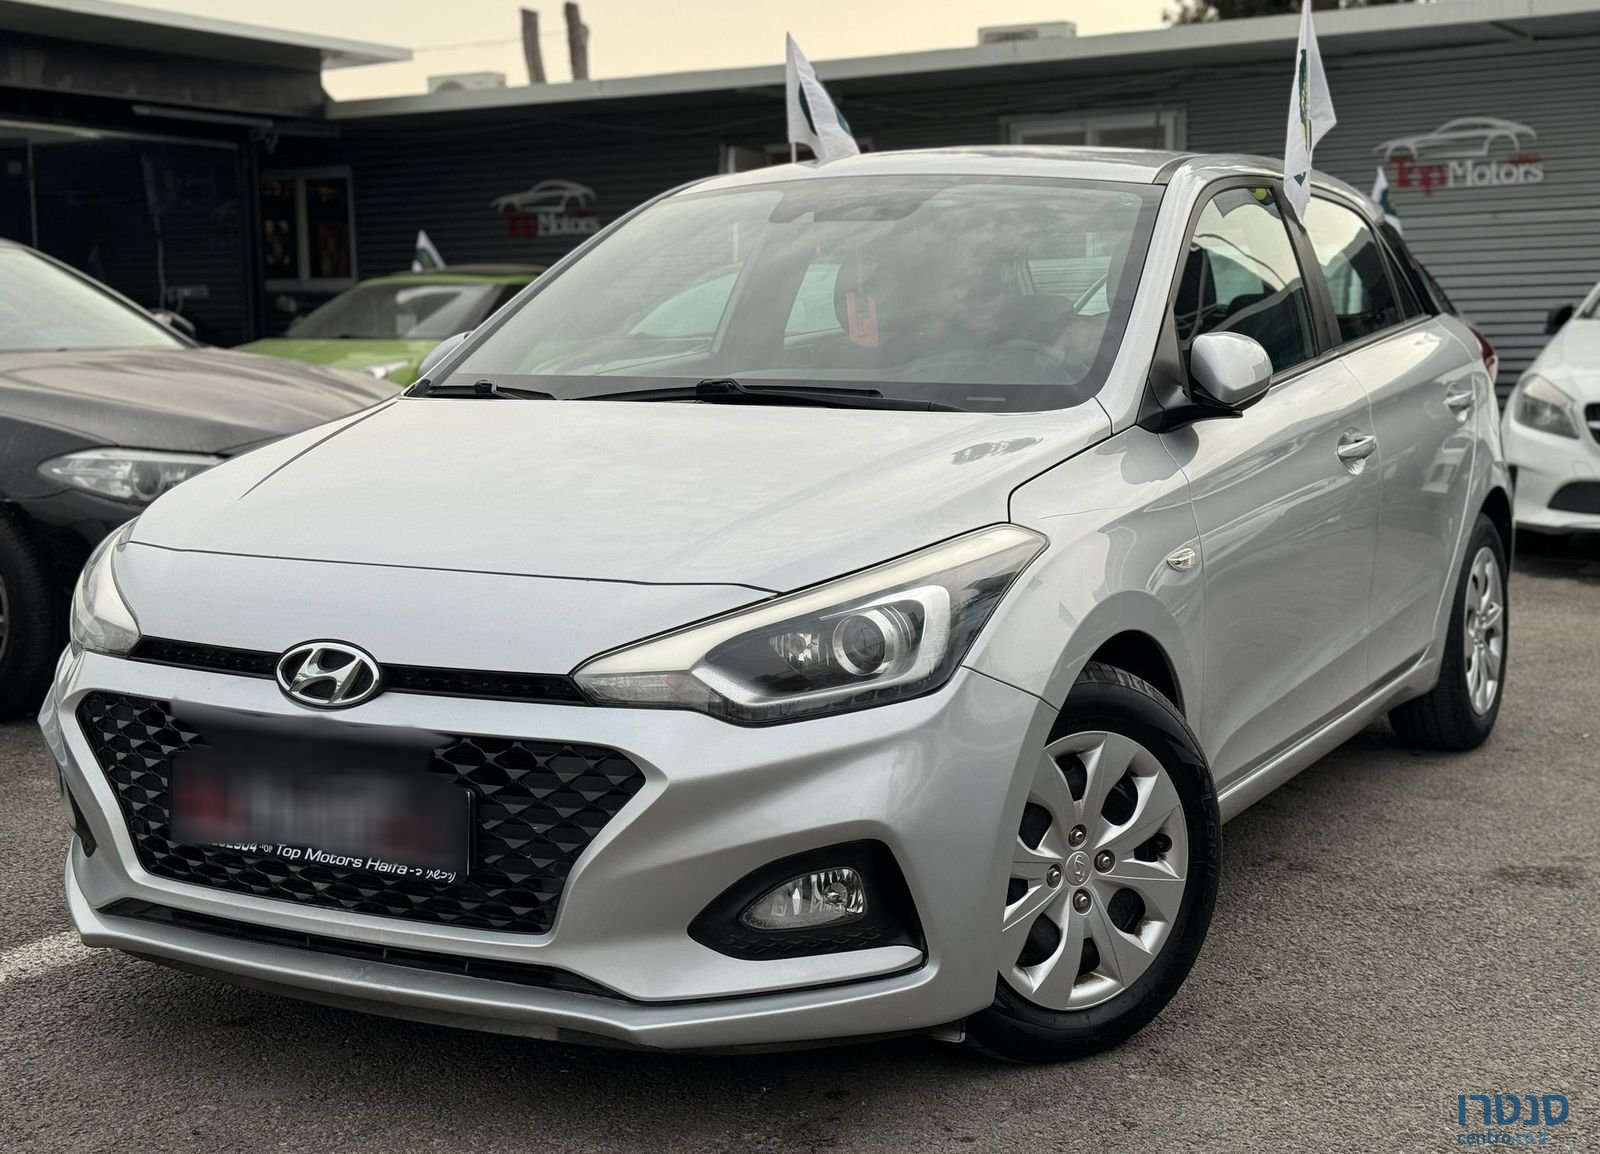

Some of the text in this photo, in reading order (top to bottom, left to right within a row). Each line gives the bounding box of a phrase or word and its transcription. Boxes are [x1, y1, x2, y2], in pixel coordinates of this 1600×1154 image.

[1447, 159, 1544, 187] Motors
[275, 843, 301, 860] Top
[304, 847, 363, 868] Motors
